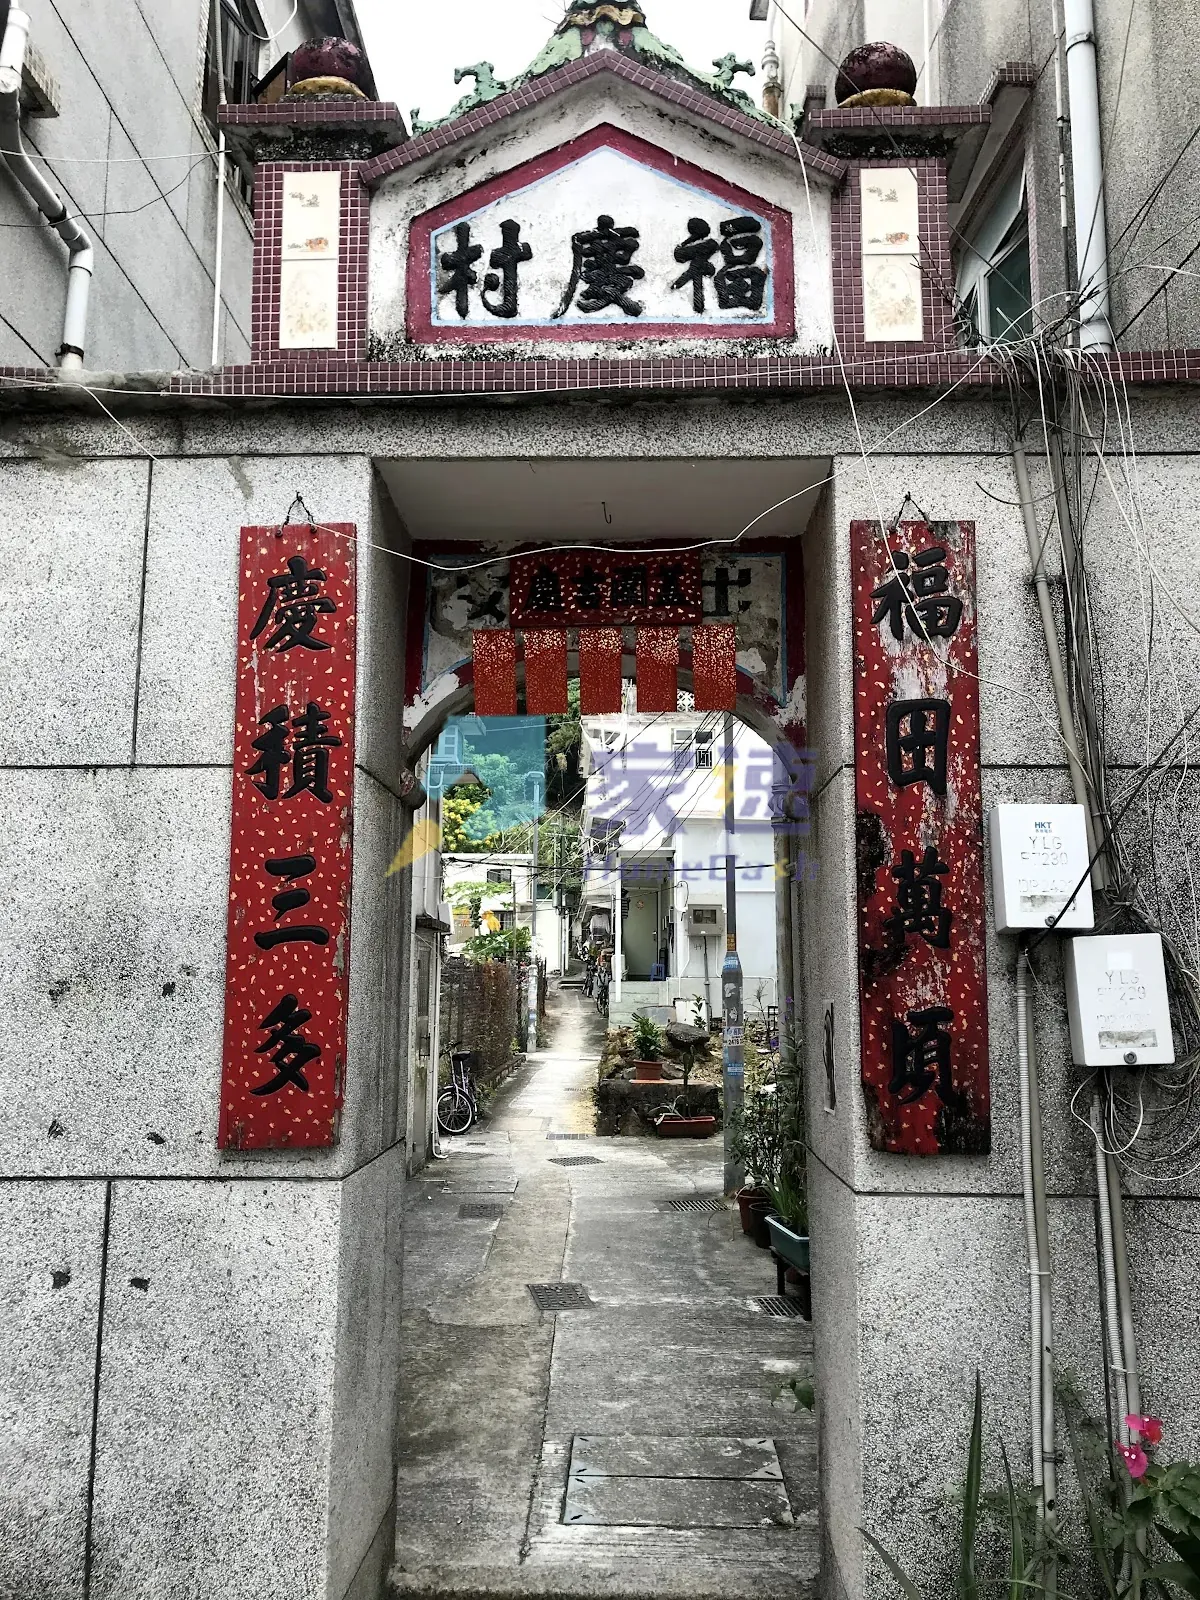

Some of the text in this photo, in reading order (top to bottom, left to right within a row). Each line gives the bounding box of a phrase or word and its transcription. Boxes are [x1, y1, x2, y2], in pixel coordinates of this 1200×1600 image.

[243, 555, 343, 1097] 慶積三多
[869, 546, 964, 1107] 福田萬頃
[1034, 821, 1053, 829] HKT
